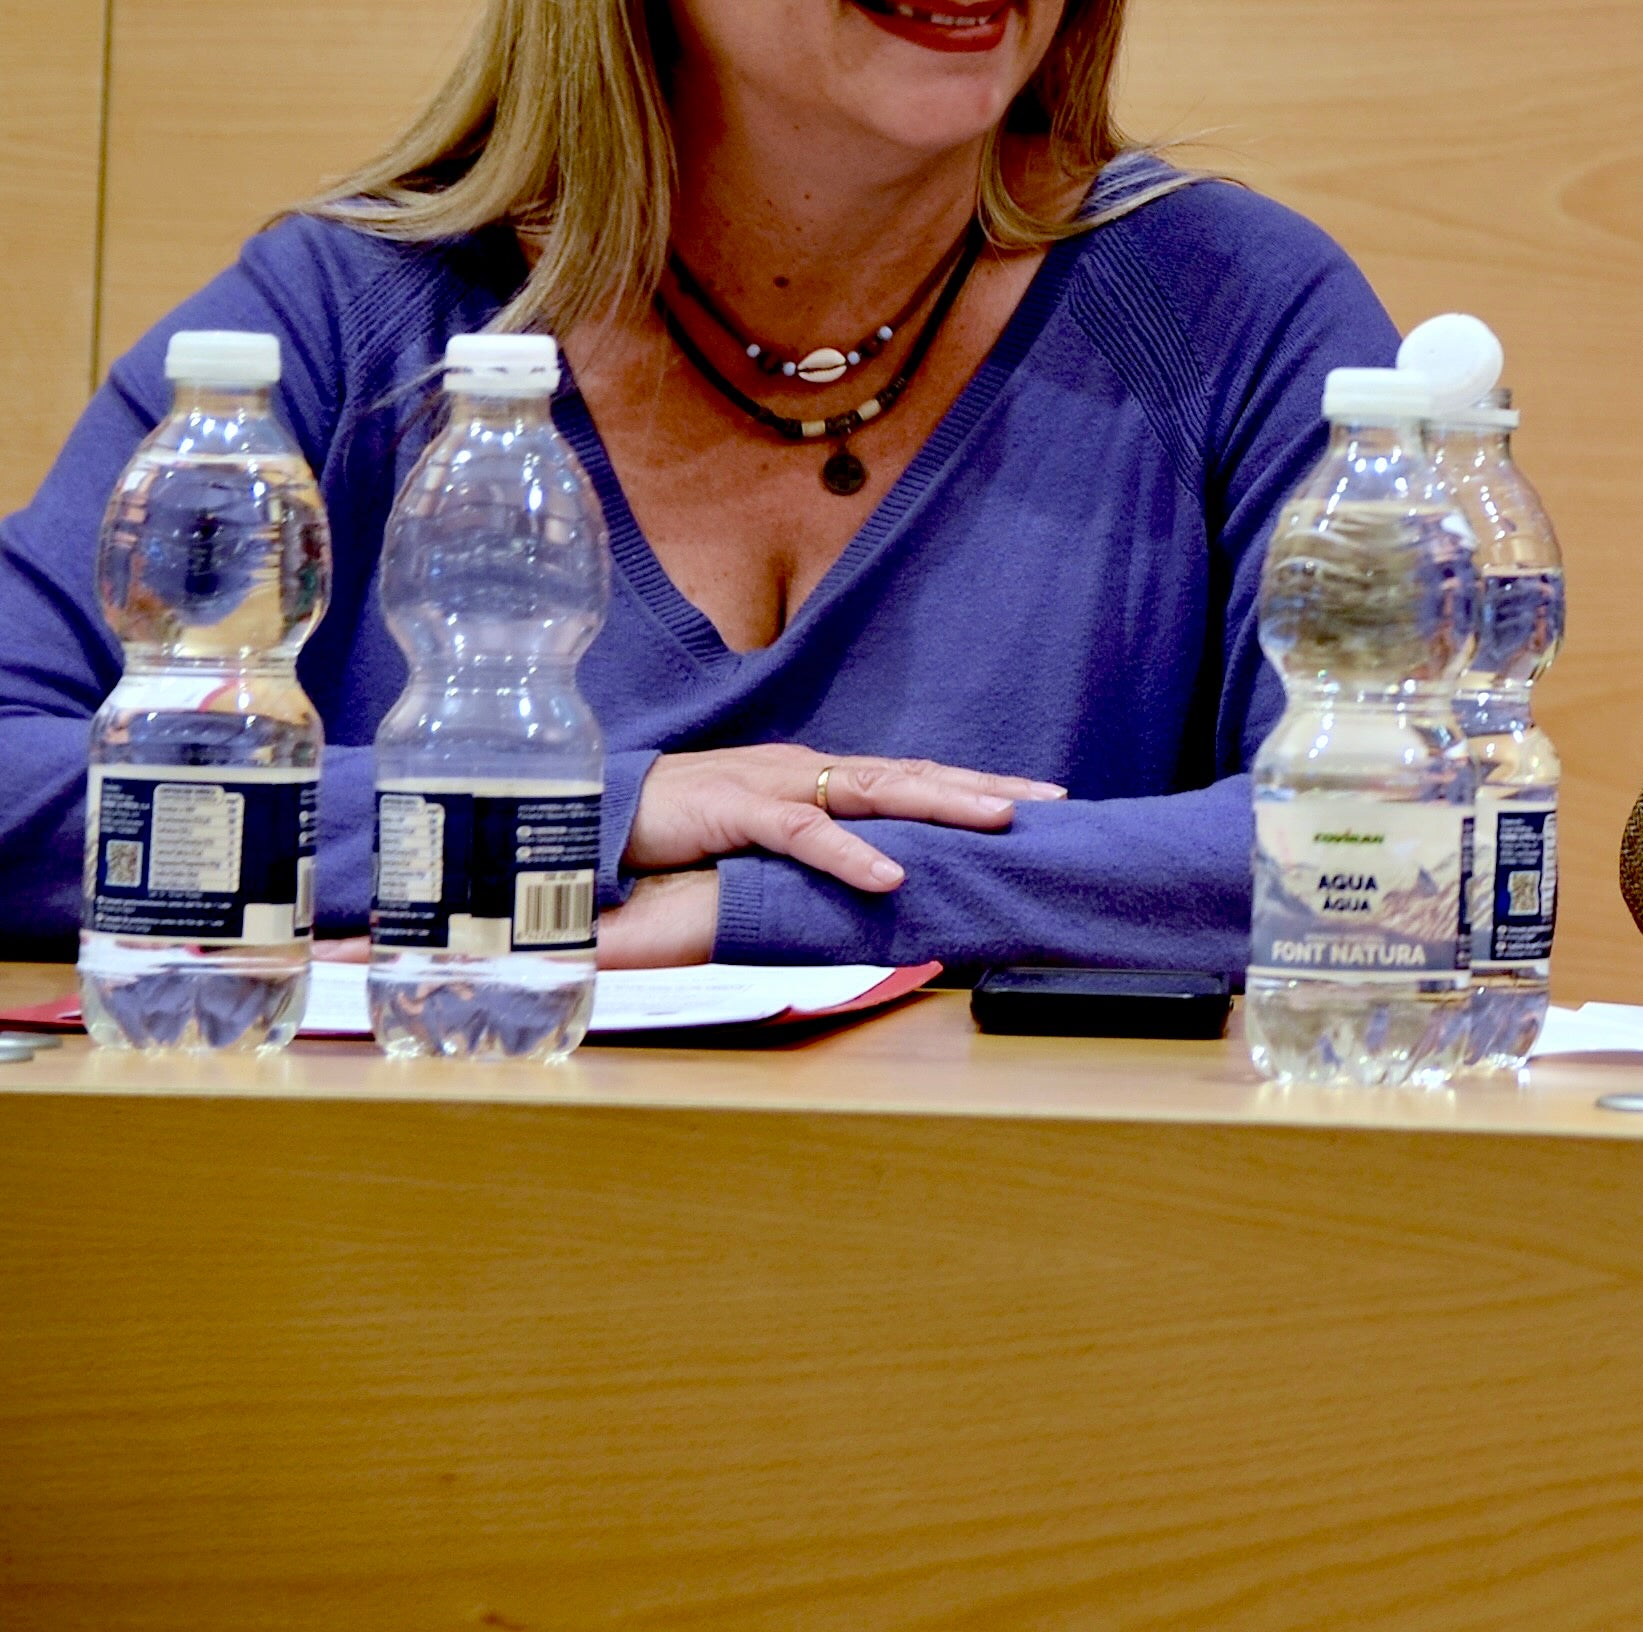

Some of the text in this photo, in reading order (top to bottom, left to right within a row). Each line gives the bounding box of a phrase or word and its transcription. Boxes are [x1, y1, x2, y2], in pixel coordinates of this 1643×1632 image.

[1317, 873, 1378, 891] AGUA
[1271, 939, 1426, 966] FONT NATURA
